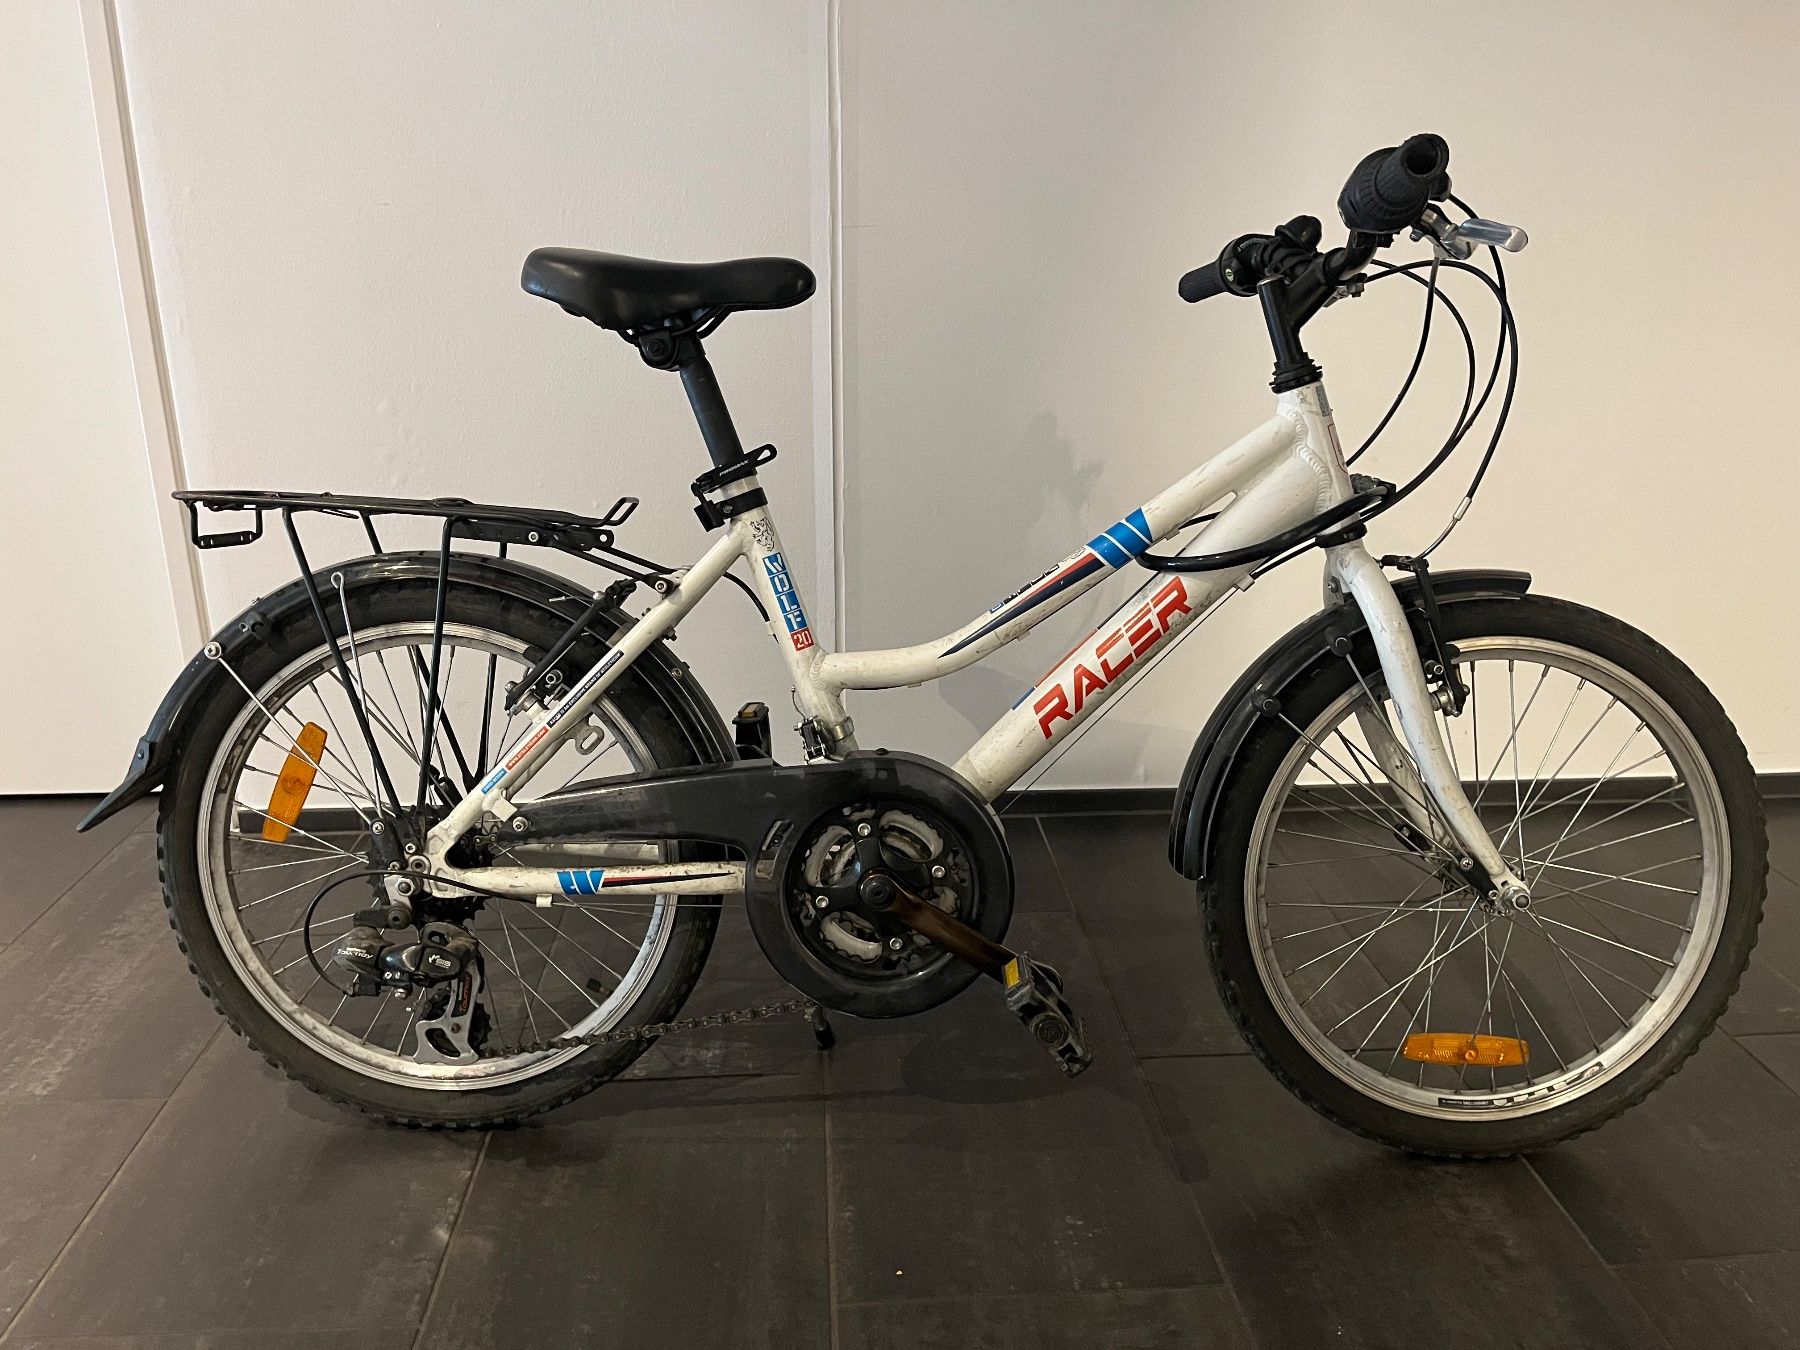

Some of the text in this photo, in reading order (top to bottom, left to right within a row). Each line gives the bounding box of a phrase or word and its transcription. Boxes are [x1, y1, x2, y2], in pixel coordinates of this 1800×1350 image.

[719, 460, 749, 477] PROMAX
[764, 554, 802, 631] WOLF
[793, 631, 812, 649] 20
[1033, 575, 1193, 740] RACER
[549, 712, 562, 725] RACER
[568, 688, 587, 706] EXCLUSIVE
[584, 677, 598, 690] BRAND
